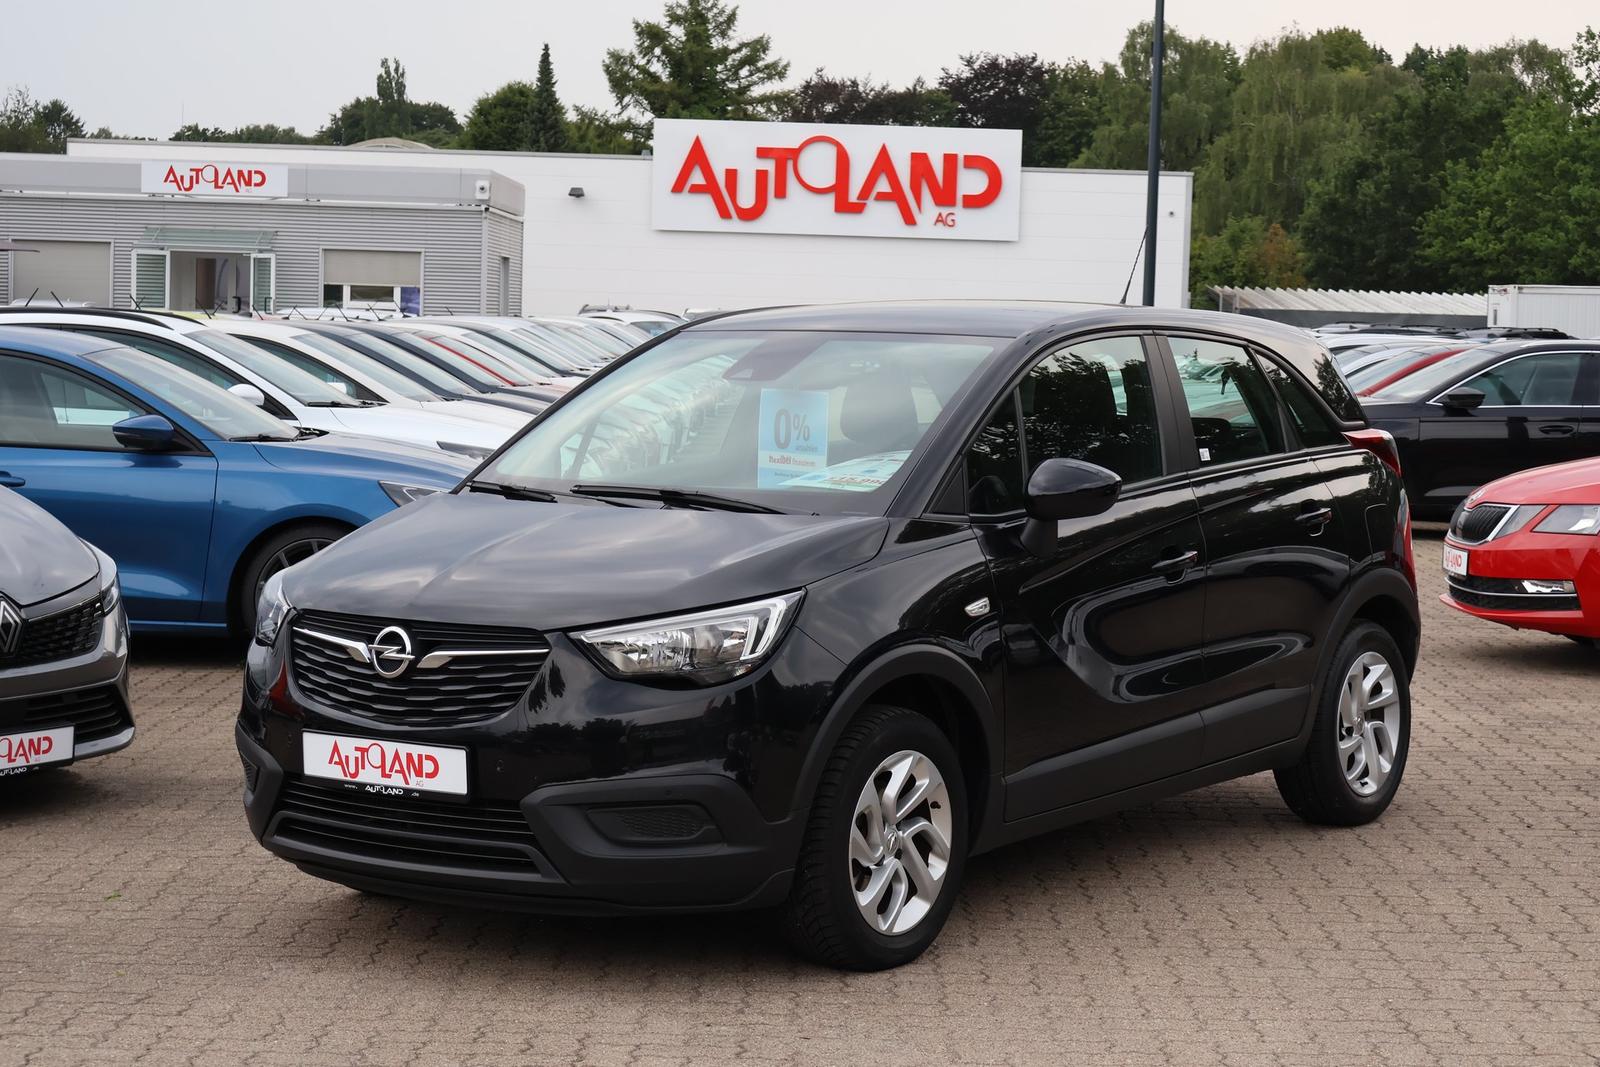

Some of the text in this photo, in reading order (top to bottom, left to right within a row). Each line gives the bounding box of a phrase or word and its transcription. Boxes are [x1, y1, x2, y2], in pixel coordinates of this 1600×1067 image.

[163, 164, 267, 193] AUTOLAND
[671, 134, 1003, 226] AUTOLAND
[934, 212, 956, 228] AG
[328, 739, 440, 786] AUTOLAND
